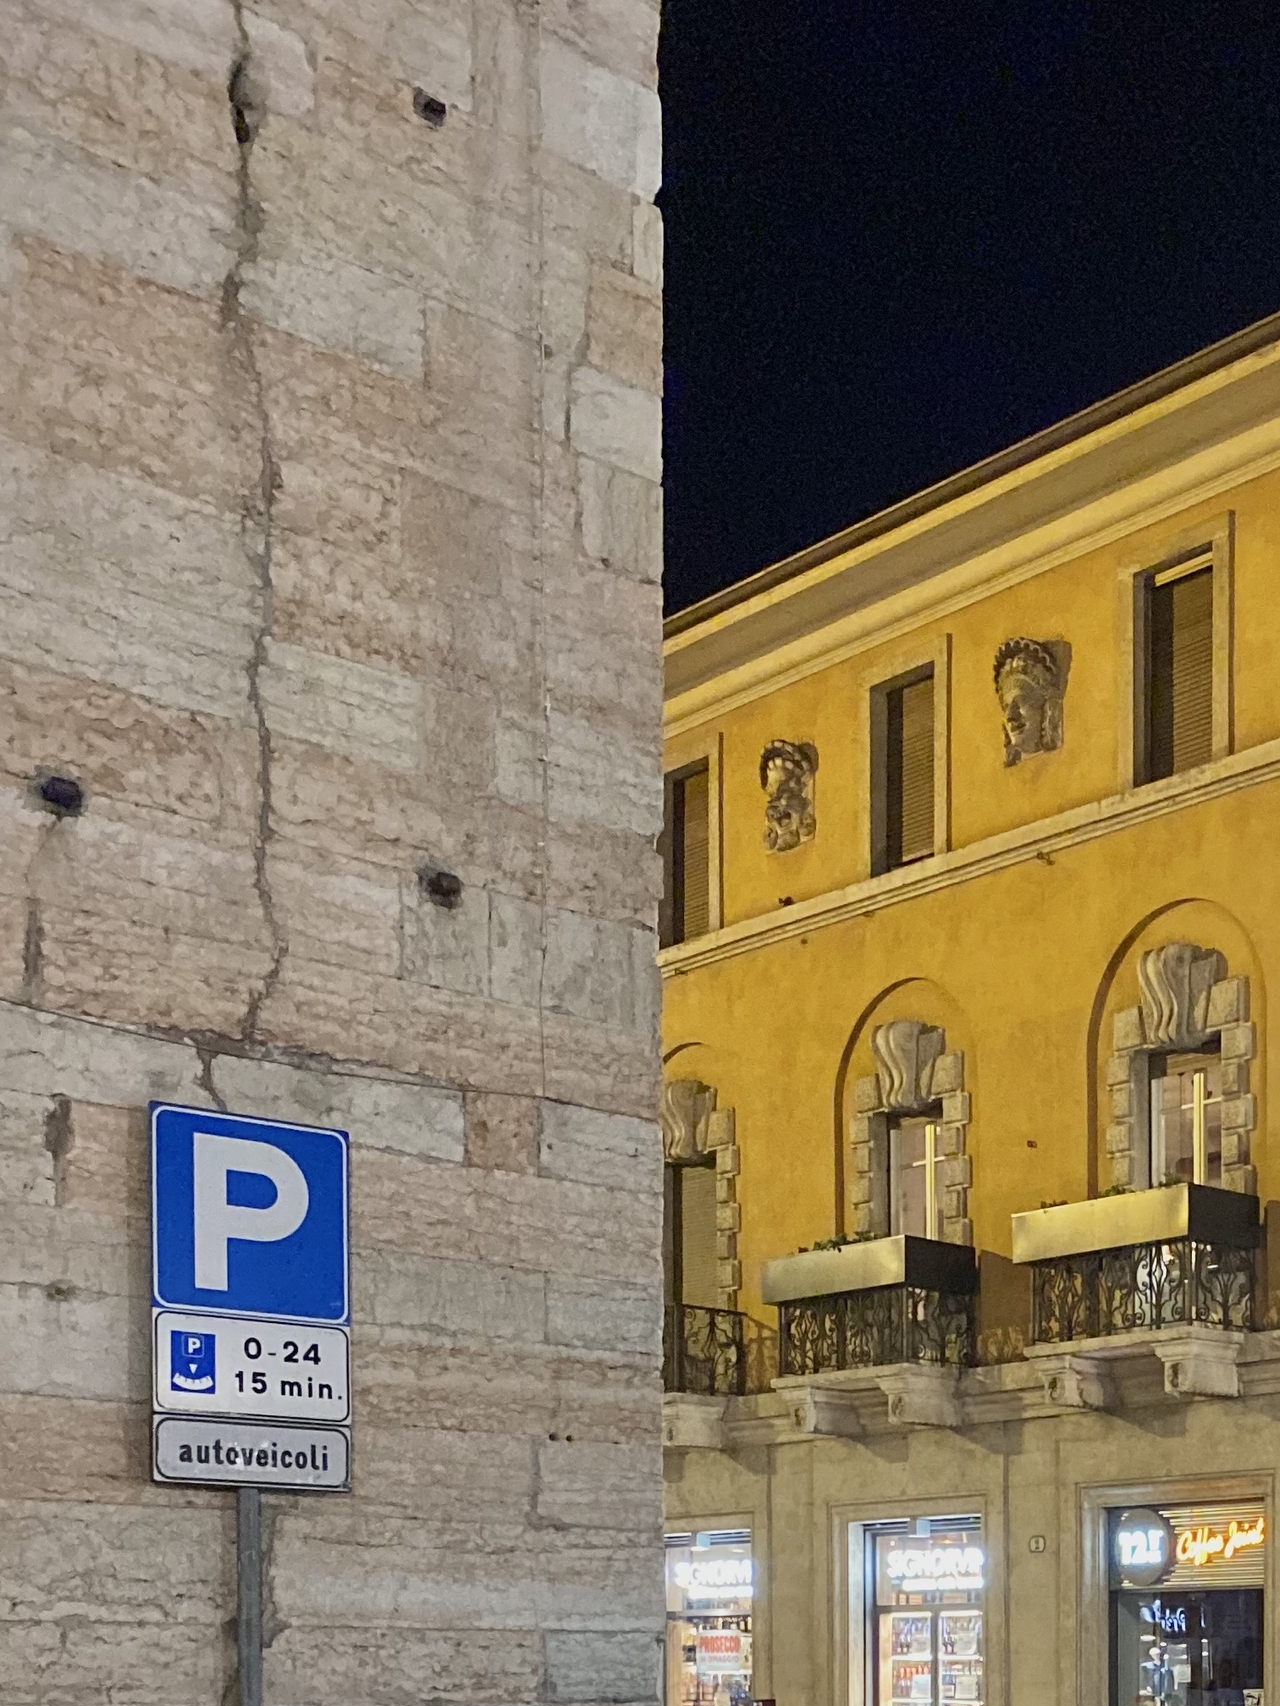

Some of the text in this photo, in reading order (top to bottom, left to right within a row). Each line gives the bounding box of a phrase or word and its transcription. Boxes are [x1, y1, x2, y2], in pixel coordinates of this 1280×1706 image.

[193, 1131, 309, 1291] P
[187, 1337, 201, 1354] P
[234, 1370, 343, 1400] 15 min.
[179, 1438, 329, 1471] autoveicoli
[1176, 1527, 1224, 1566] Coffee
[1224, 1517, 1264, 1558] Joint
[699, 1636, 741, 1653] PROSECCO
